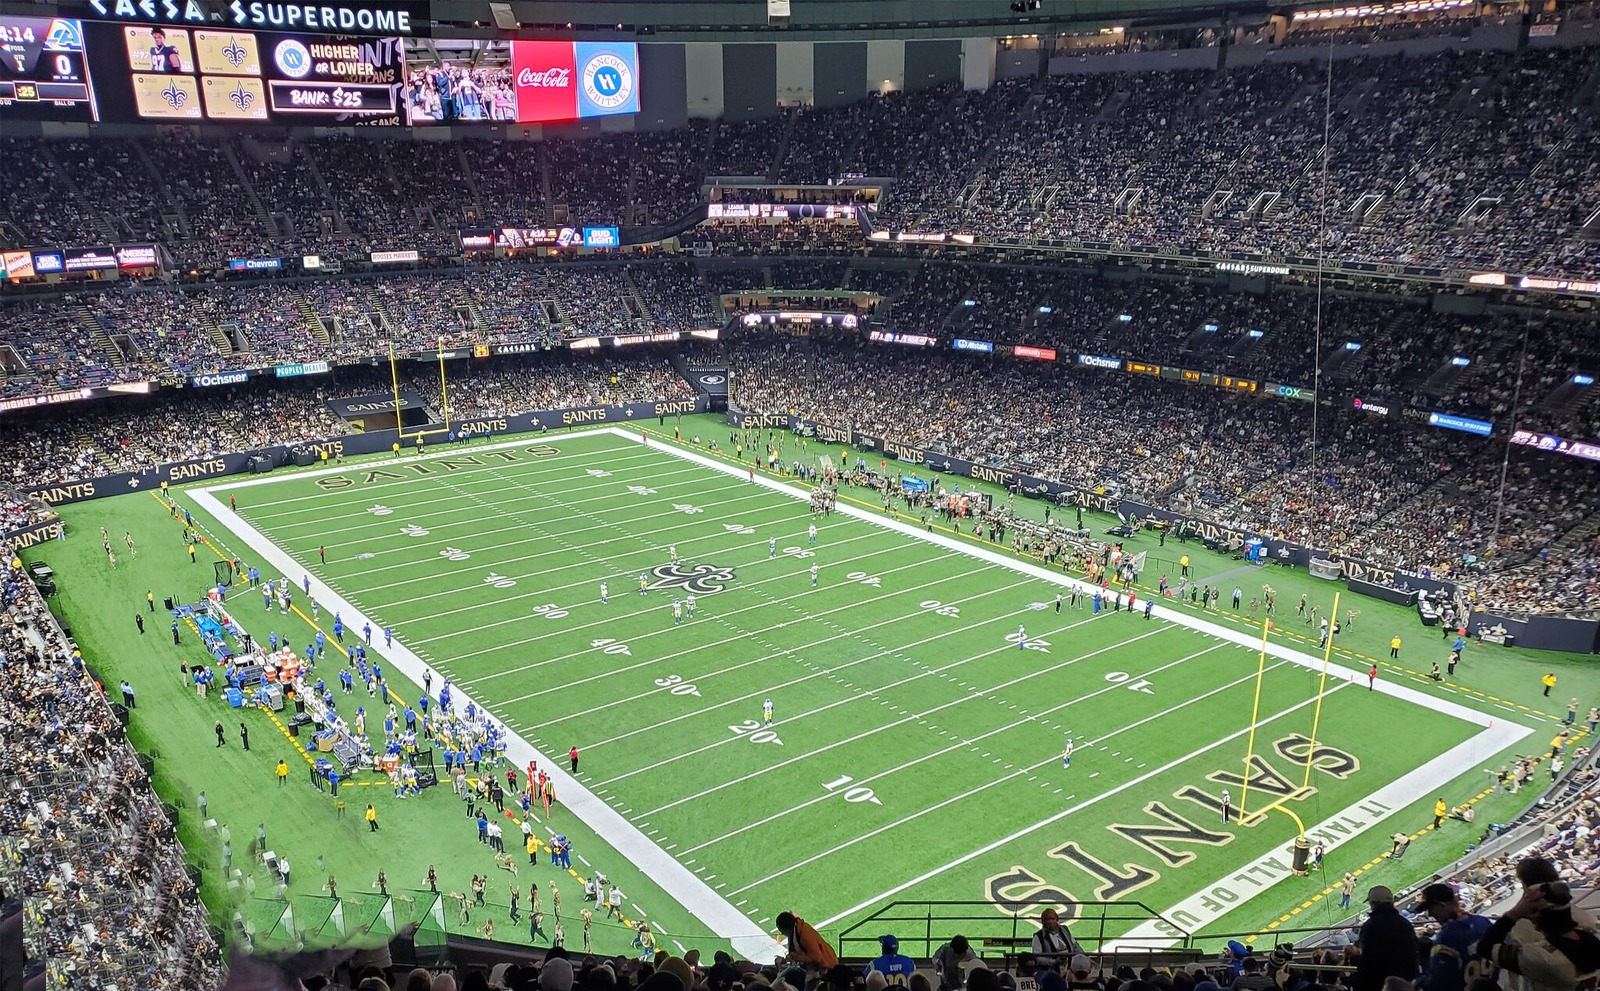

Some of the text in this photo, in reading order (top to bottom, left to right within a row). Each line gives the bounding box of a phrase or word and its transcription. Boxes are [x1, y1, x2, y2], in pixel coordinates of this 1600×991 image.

[90, 0, 411, 31] CAESAS SUPERDOME
[310, 44, 359, 58] HIGHER
[17, 61, 25, 71] 1
[56, 54, 72, 75] 0
[315, 62, 373, 75] OR LOWER
[586, 56, 629, 78] HANCOCK
[517, 67, 571, 88] Coca-Cola
[290, 86, 362, 106] BANK: $25
[586, 85, 629, 106] WHITNEY
[462, 236, 490, 246] verizon
[530, 229, 546, 238] 4:14
[588, 237, 614, 245] LIGHT
[246, 259, 278, 268] Chevron
[394, 251, 417, 260] MARKETS
[1215, 262, 1290, 275] CAESARS SUPERDOME
[497, 344, 536, 353] CAESARS
[276, 363, 328, 377] PEOPLES HEALTH
[1085, 356, 1120, 369] Ochsner
[160, 377, 187, 387] SAINTS
[200, 373, 247, 386] Ochsner
[1279, 385, 1300, 397] COX
[1, 397, 36, 410] HIGHER
[48, 391, 82, 403] LOWER
[345, 399, 409, 412] SAINTS
[655, 400, 696, 415] SAINTS
[1361, 403, 1388, 415] entergy
[563, 408, 606, 424] SAINTS
[744, 415, 788, 428] SAINTS
[461, 419, 507, 434] SAINTS
[816, 424, 849, 443] SAINTS
[888, 442, 924, 463] SAINTS
[169, 458, 226, 481] SAINTS
[315, 445, 562, 490] SAINTS
[28, 481, 95, 502] SAINTS
[1187, 520, 1245, 547] SAINTS
[1339, 559, 1395, 583] AINTS
[483, 572, 517, 588] 40
[532, 603, 570, 619] 50
[590, 638, 629, 655] 40
[654, 674, 699, 696] 30
[1104, 670, 1155, 695] 10
[728, 719, 778, 744] 20
[821, 774, 874, 803] 10
[1363, 798, 1392, 820] IT
[984, 732, 1361, 930] SAINTS
[1231, 856, 1292, 887] ALL
[1199, 887, 1240, 914] OF
[1152, 910, 1202, 938] US
